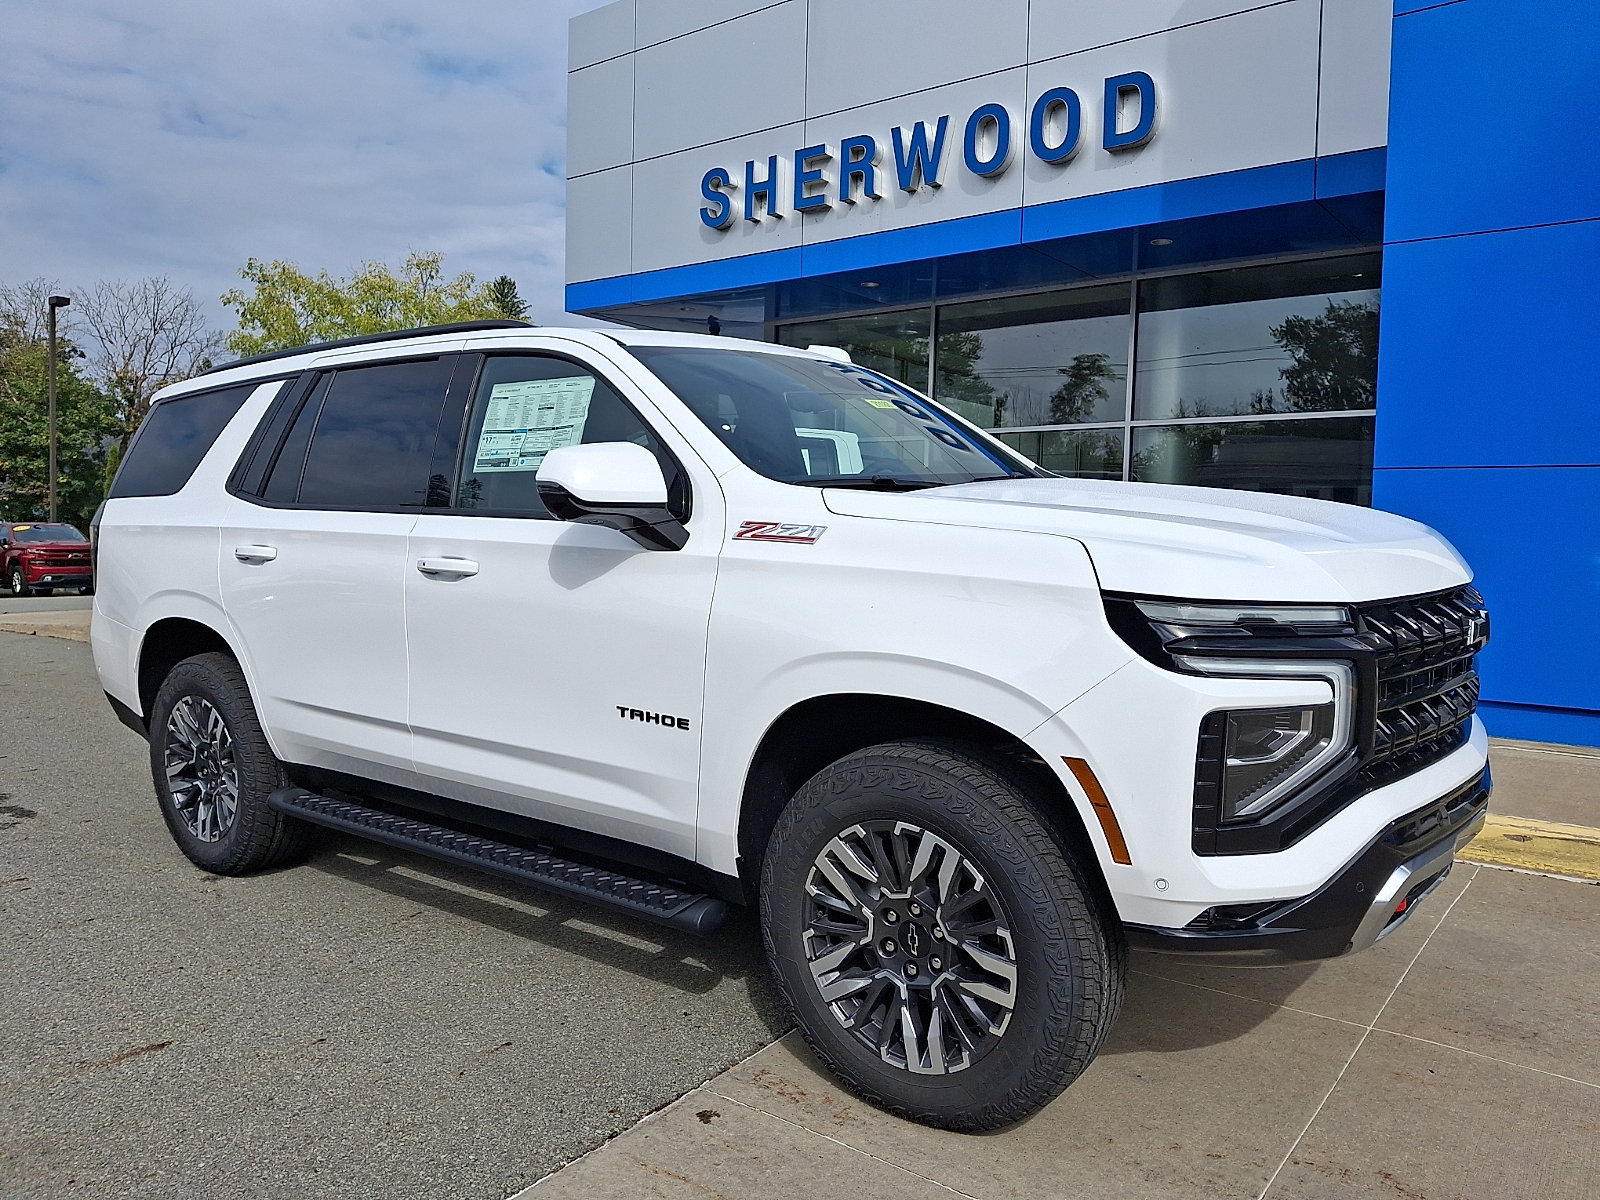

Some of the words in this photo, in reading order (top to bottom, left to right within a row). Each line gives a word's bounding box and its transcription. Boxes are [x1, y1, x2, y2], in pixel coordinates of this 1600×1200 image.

[699, 70, 1158, 230] SHERWOOD
[732, 520, 828, 545] Z71
[616, 705, 690, 731] TAHOE
